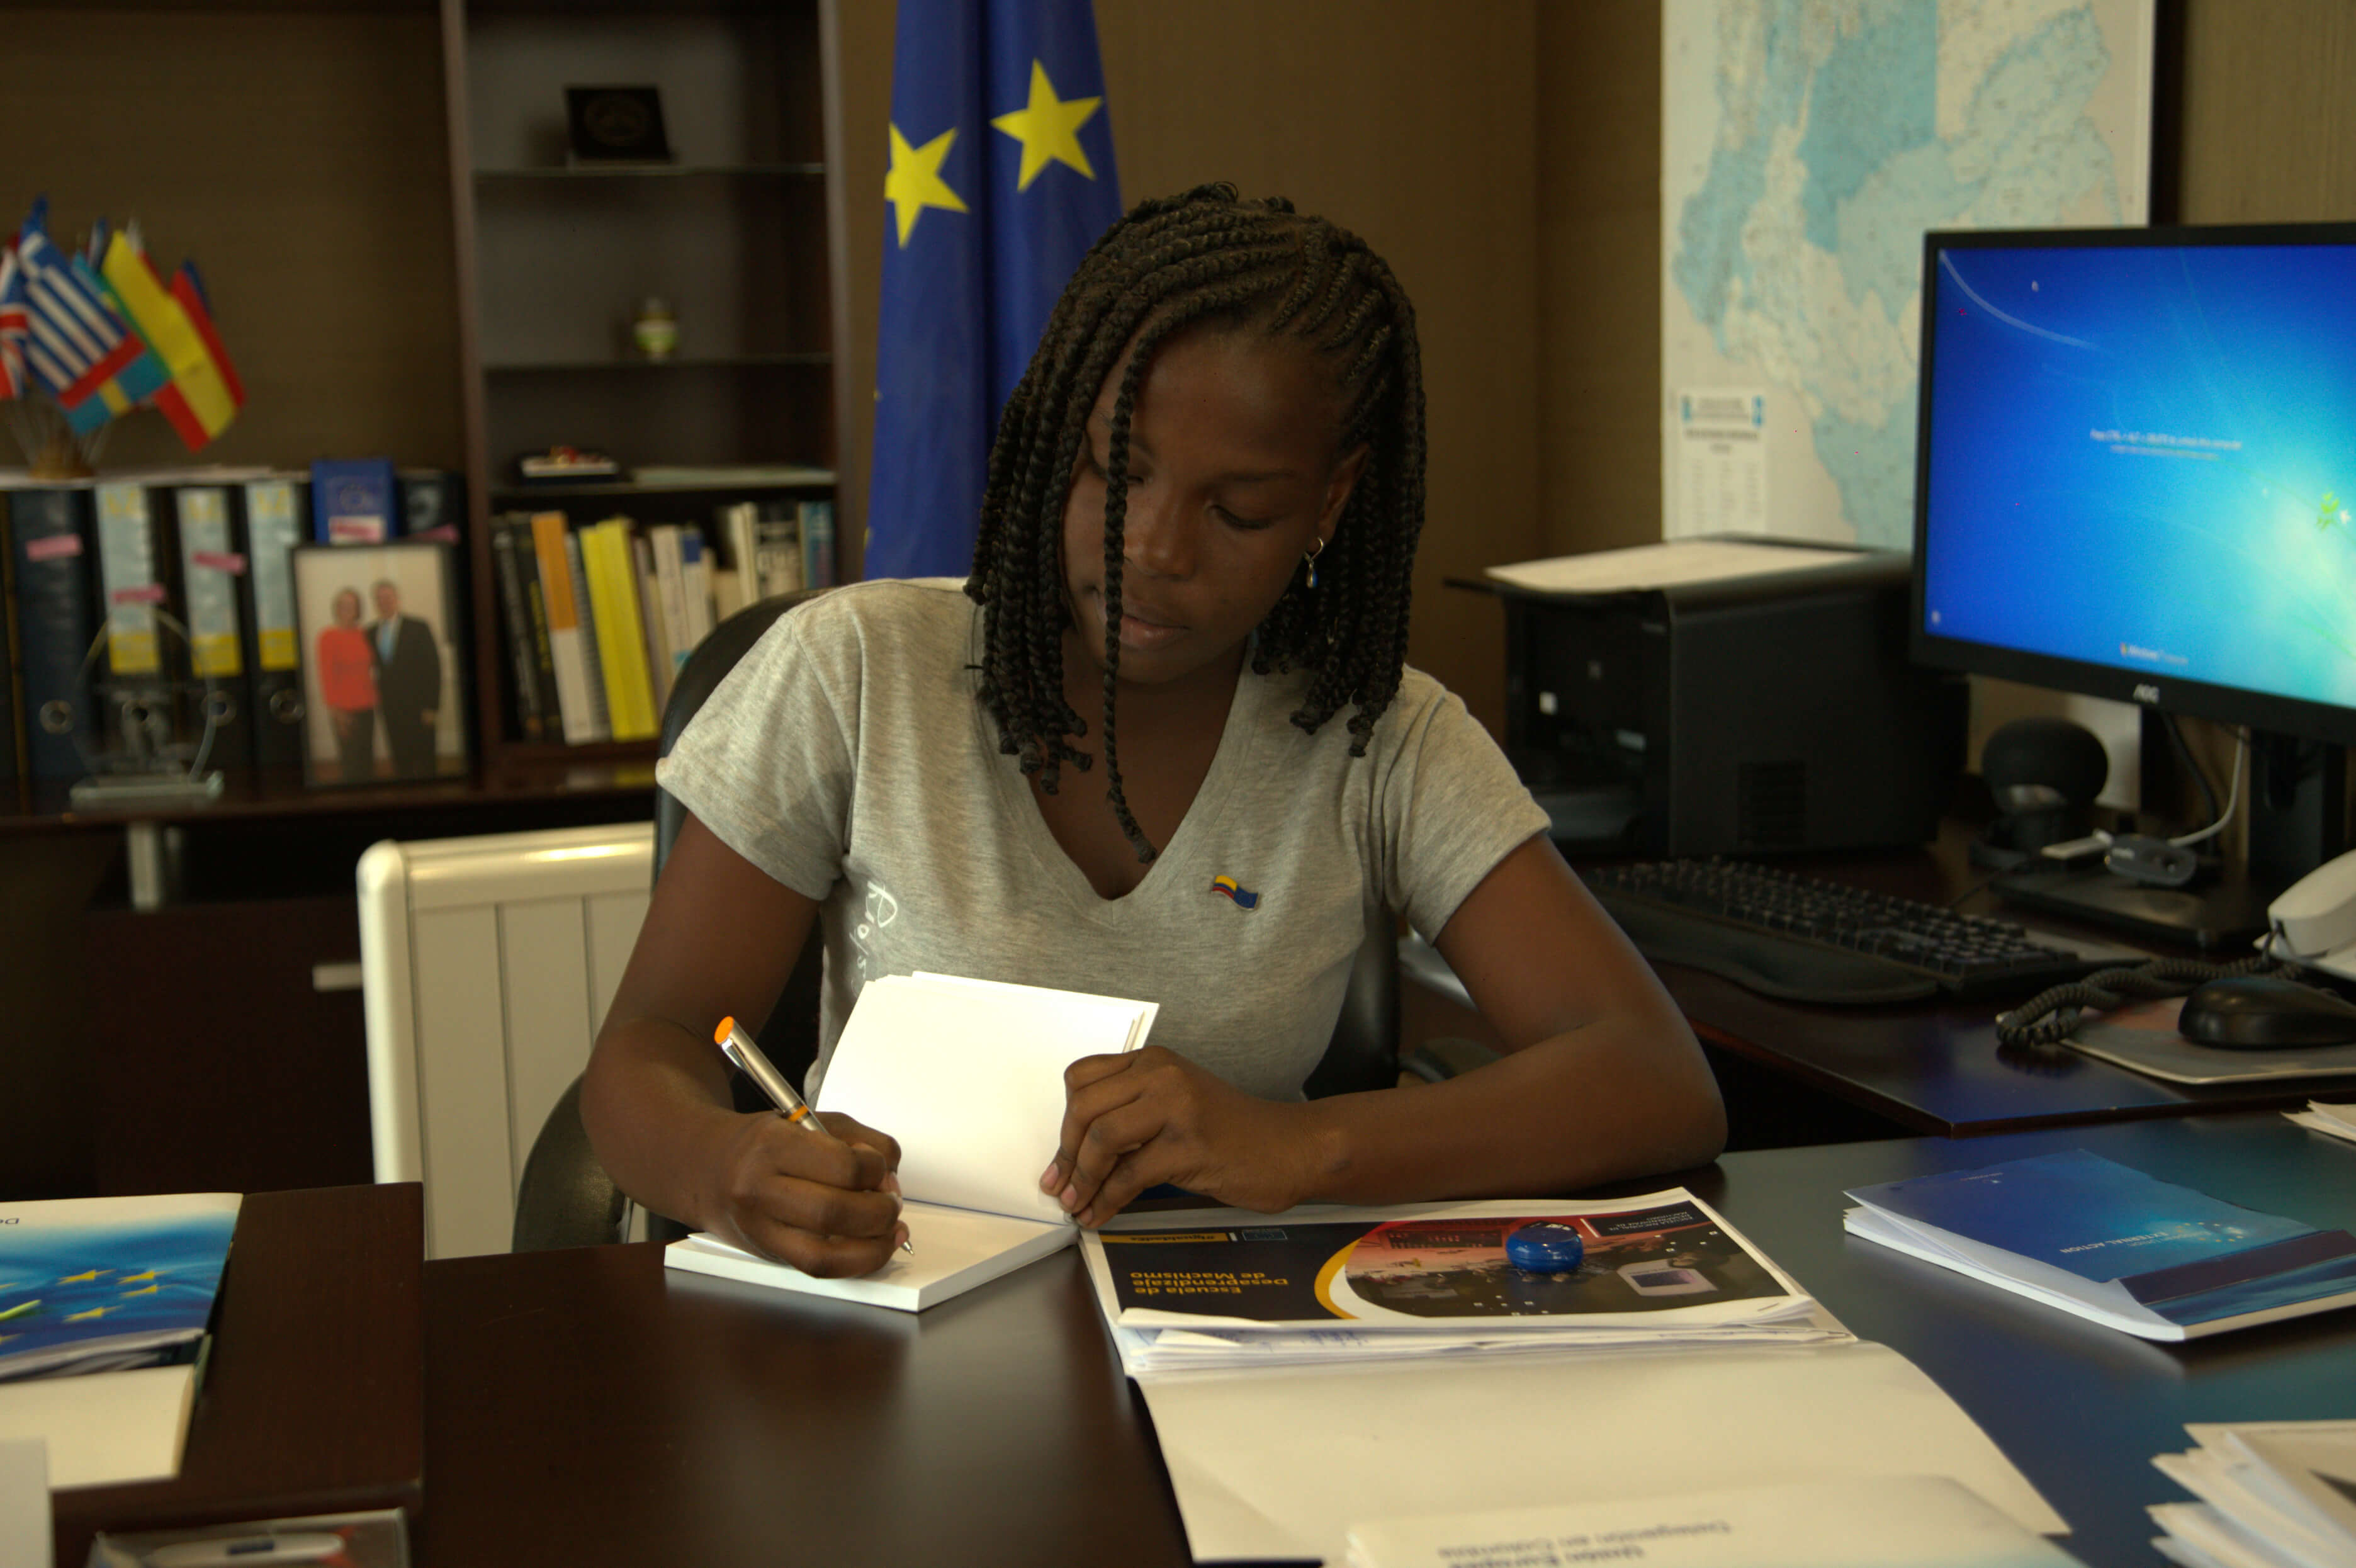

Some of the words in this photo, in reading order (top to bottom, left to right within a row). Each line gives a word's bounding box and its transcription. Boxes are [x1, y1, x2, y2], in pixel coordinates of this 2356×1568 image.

[2059, 1241, 2104, 1253] ACTION
[1129, 1271, 1234, 1279] Machismo
[1131, 1278, 1288, 1286] Desaprendizaje
[1134, 1287, 1159, 1295] de
[1164, 1286, 1241, 1295] Escuela
